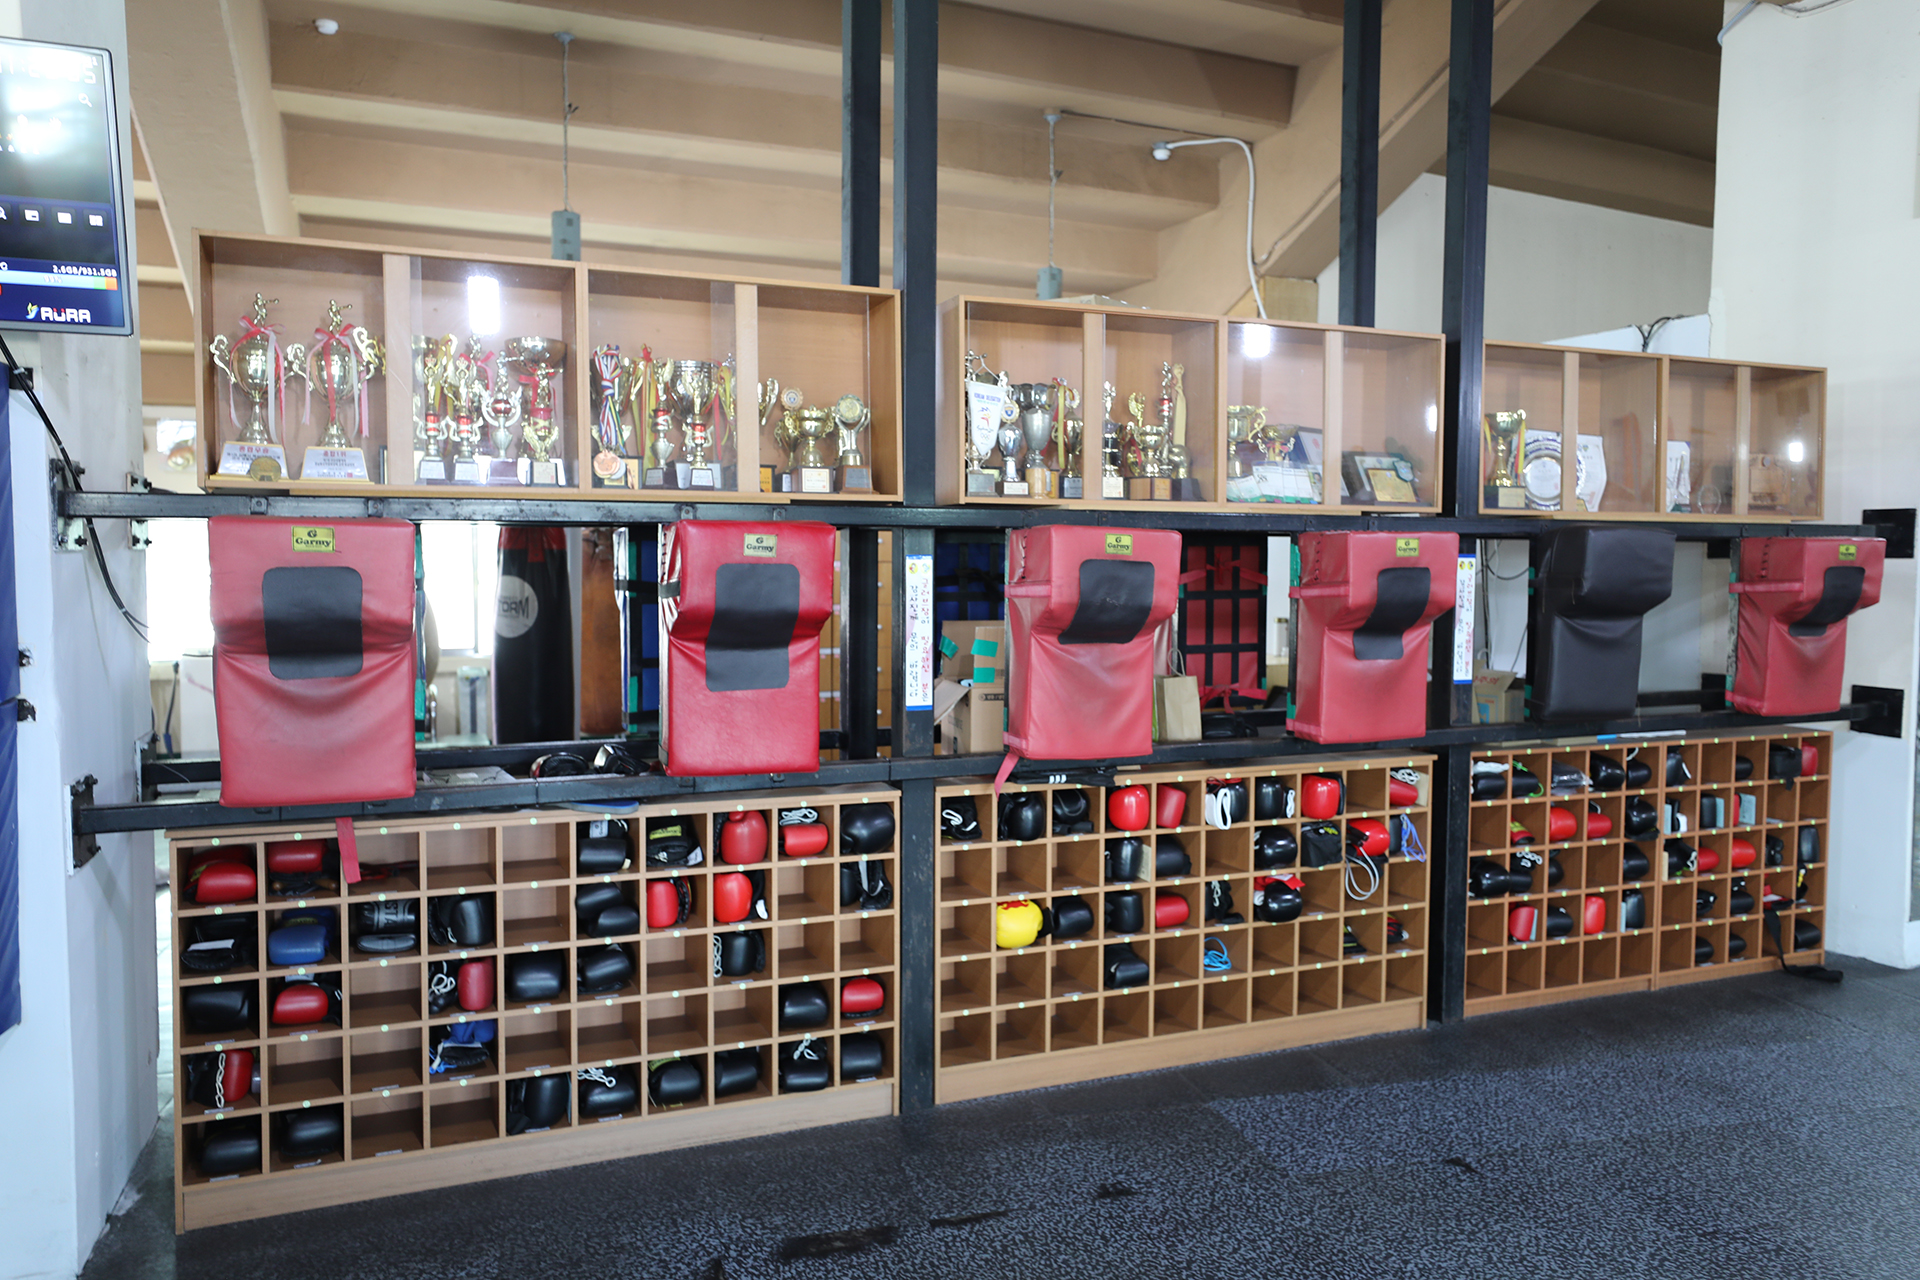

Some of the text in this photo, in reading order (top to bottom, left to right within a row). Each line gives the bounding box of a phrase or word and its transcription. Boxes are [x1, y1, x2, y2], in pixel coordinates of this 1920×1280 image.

[295, 537, 331, 547] Garmy
[746, 544, 774, 552] Garmy
[1108, 543, 1130, 551] Garmy
